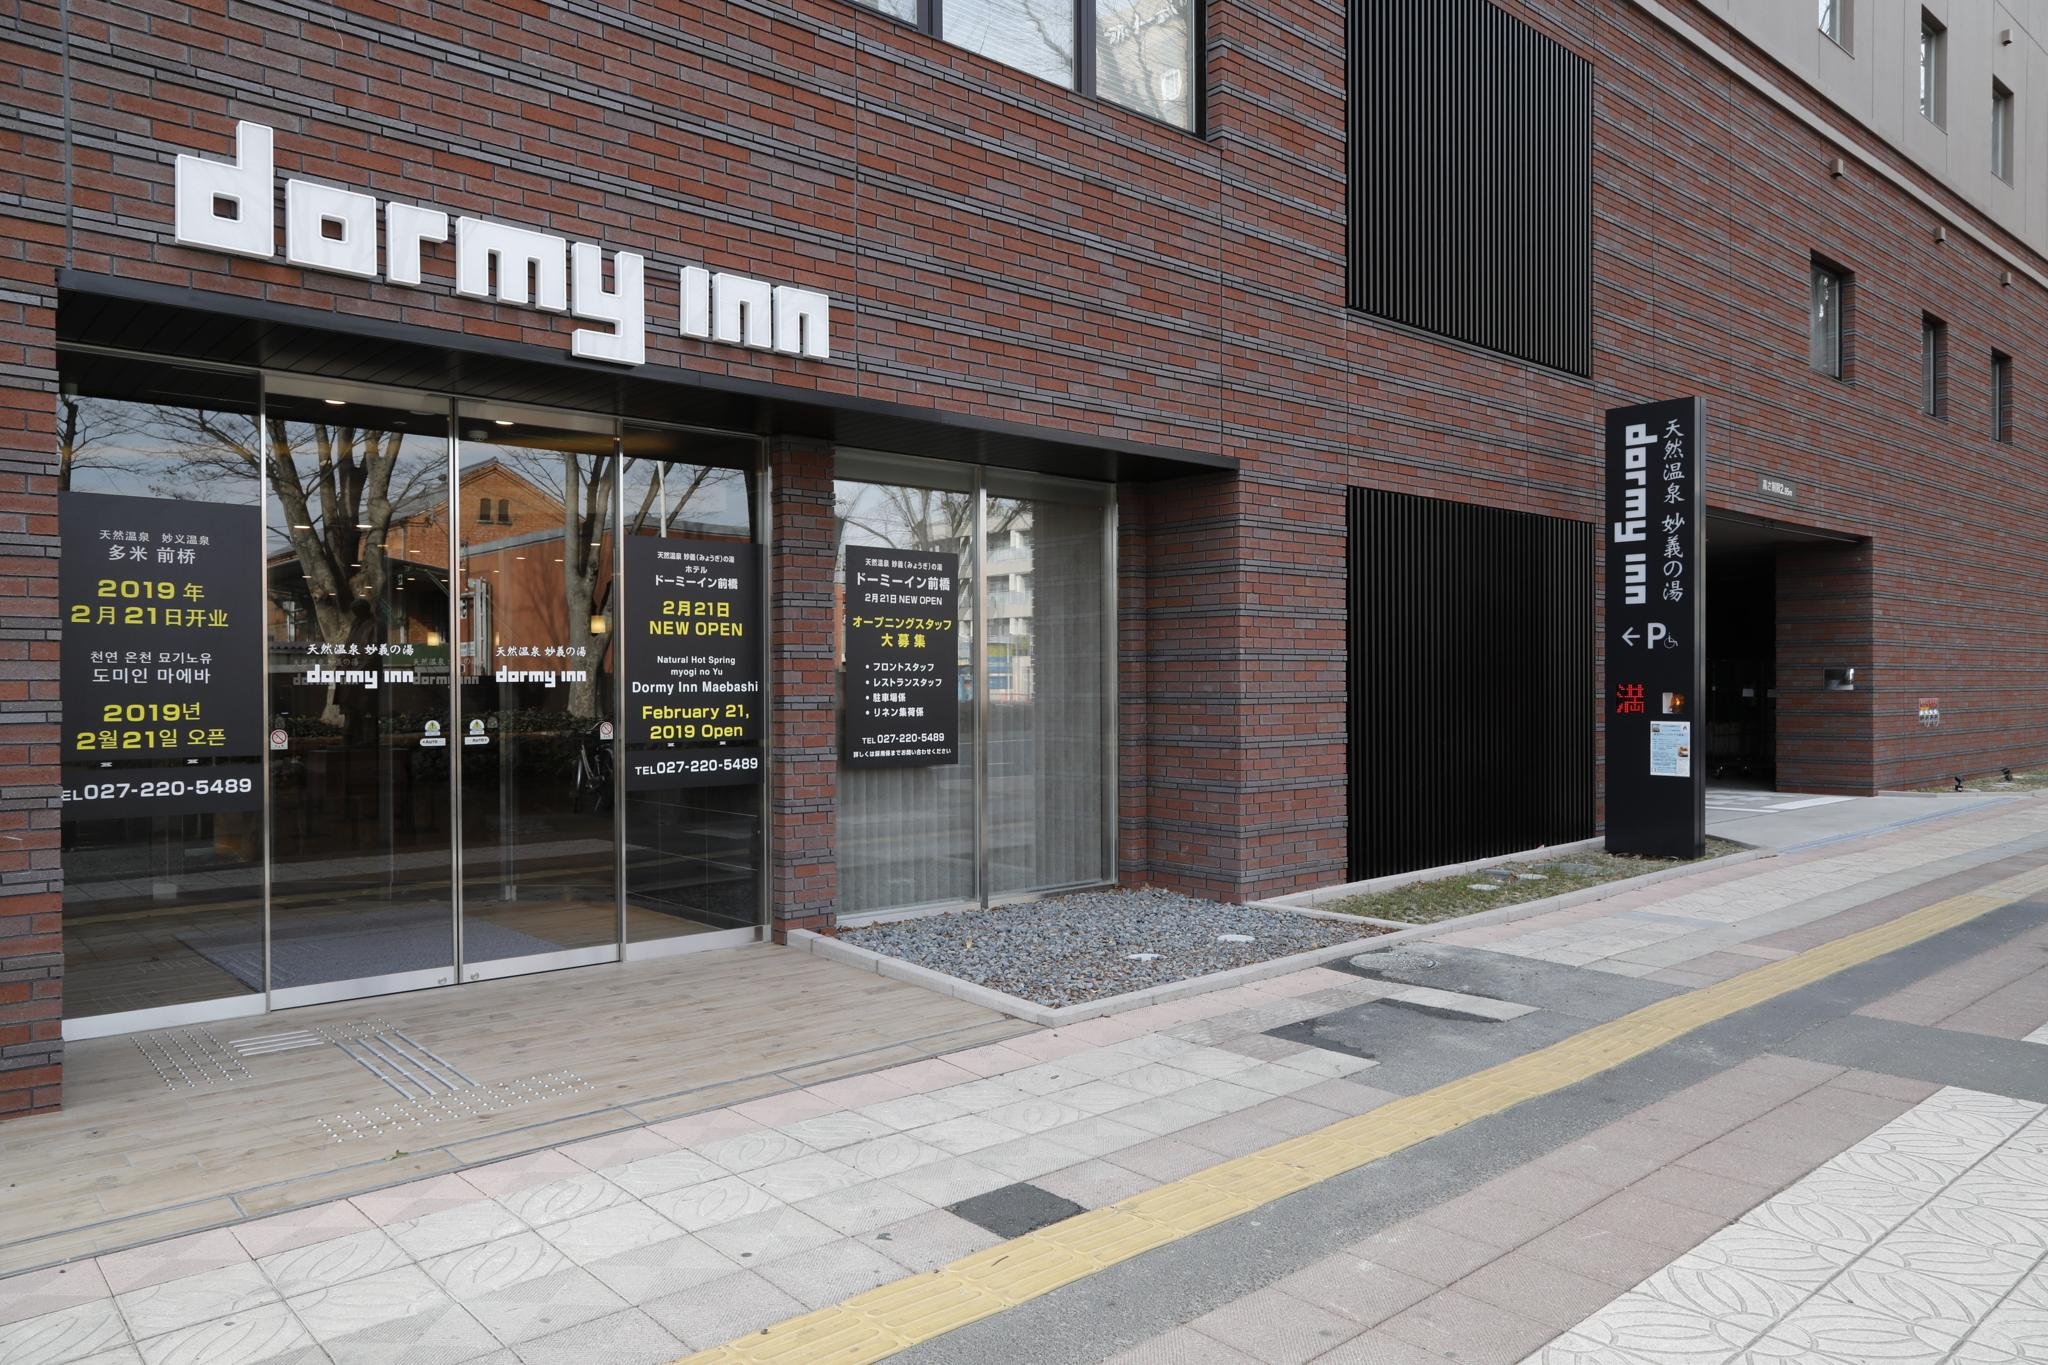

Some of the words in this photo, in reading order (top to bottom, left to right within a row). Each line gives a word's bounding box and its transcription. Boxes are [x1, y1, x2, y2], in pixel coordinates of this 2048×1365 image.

[174, 120, 646, 366] dormy
[680, 265, 830, 360] inn
[1663, 418, 1686, 504] 天然温泉
[1614, 423, 1658, 542] dormy
[99, 529, 150, 543] 天然温泉
[161, 533, 211, 546] 妙义温泉
[108, 545, 149, 562] 多米
[156, 547, 196, 565] 前桥
[1662, 512, 1685, 602] 妙義の湯
[685, 565, 708, 574] ホテル
[655, 574, 739, 590] ドーミーイン前橋
[856, 571, 951, 592] ドーミーイン前橋
[1625, 553, 1647, 605] inn
[98, 579, 176, 600] 2019
[183, 582, 205, 603] 年
[898, 595, 918, 605] NEW
[919, 596, 943, 606] OPEN
[649, 620, 689, 636] NEW
[695, 622, 743, 637] OPEN
[852, 615, 952, 632] オープニングスタッフ
[1647, 621, 1666, 649] P
[90, 651, 118, 664] 천연
[125, 651, 152, 664] 온천
[158, 651, 212, 665] 묘기노유
[306, 643, 361, 656] 天然温泉
[364, 643, 415, 657] 妙義の湯
[496, 645, 541, 658] 天然温泉
[545, 645, 588, 658] 妙義の湯
[657, 655, 689, 664] Natural
[691, 655, 706, 664] Hot
[708, 655, 736, 666] Spring
[873, 662, 935, 673] フロントスタッフ
[92, 667, 149, 685] 도미인
[157, 667, 212, 685] 마에바
[306, 664, 378, 690] dormy
[384, 670, 414, 683] inn
[496, 665, 557, 688] dormy
[561, 670, 587, 683] inn
[670, 667, 697, 677] myogi
[699, 669, 710, 677] no
[712, 668, 723, 676] Yu
[632, 681, 674, 696] Dormy
[678, 681, 698, 693] Inn
[702, 681, 759, 693] Maebashi
[873, 677, 943, 688] レストランスタッフ
[1616, 683, 1645, 714] 満
[103, 702, 202, 723] 2019년
[642, 705, 720, 722] February
[725, 704, 750, 720] 21,
[187, 728, 227, 748] 오픈
[650, 725, 696, 740] 2019
[701, 724, 743, 741] Open
